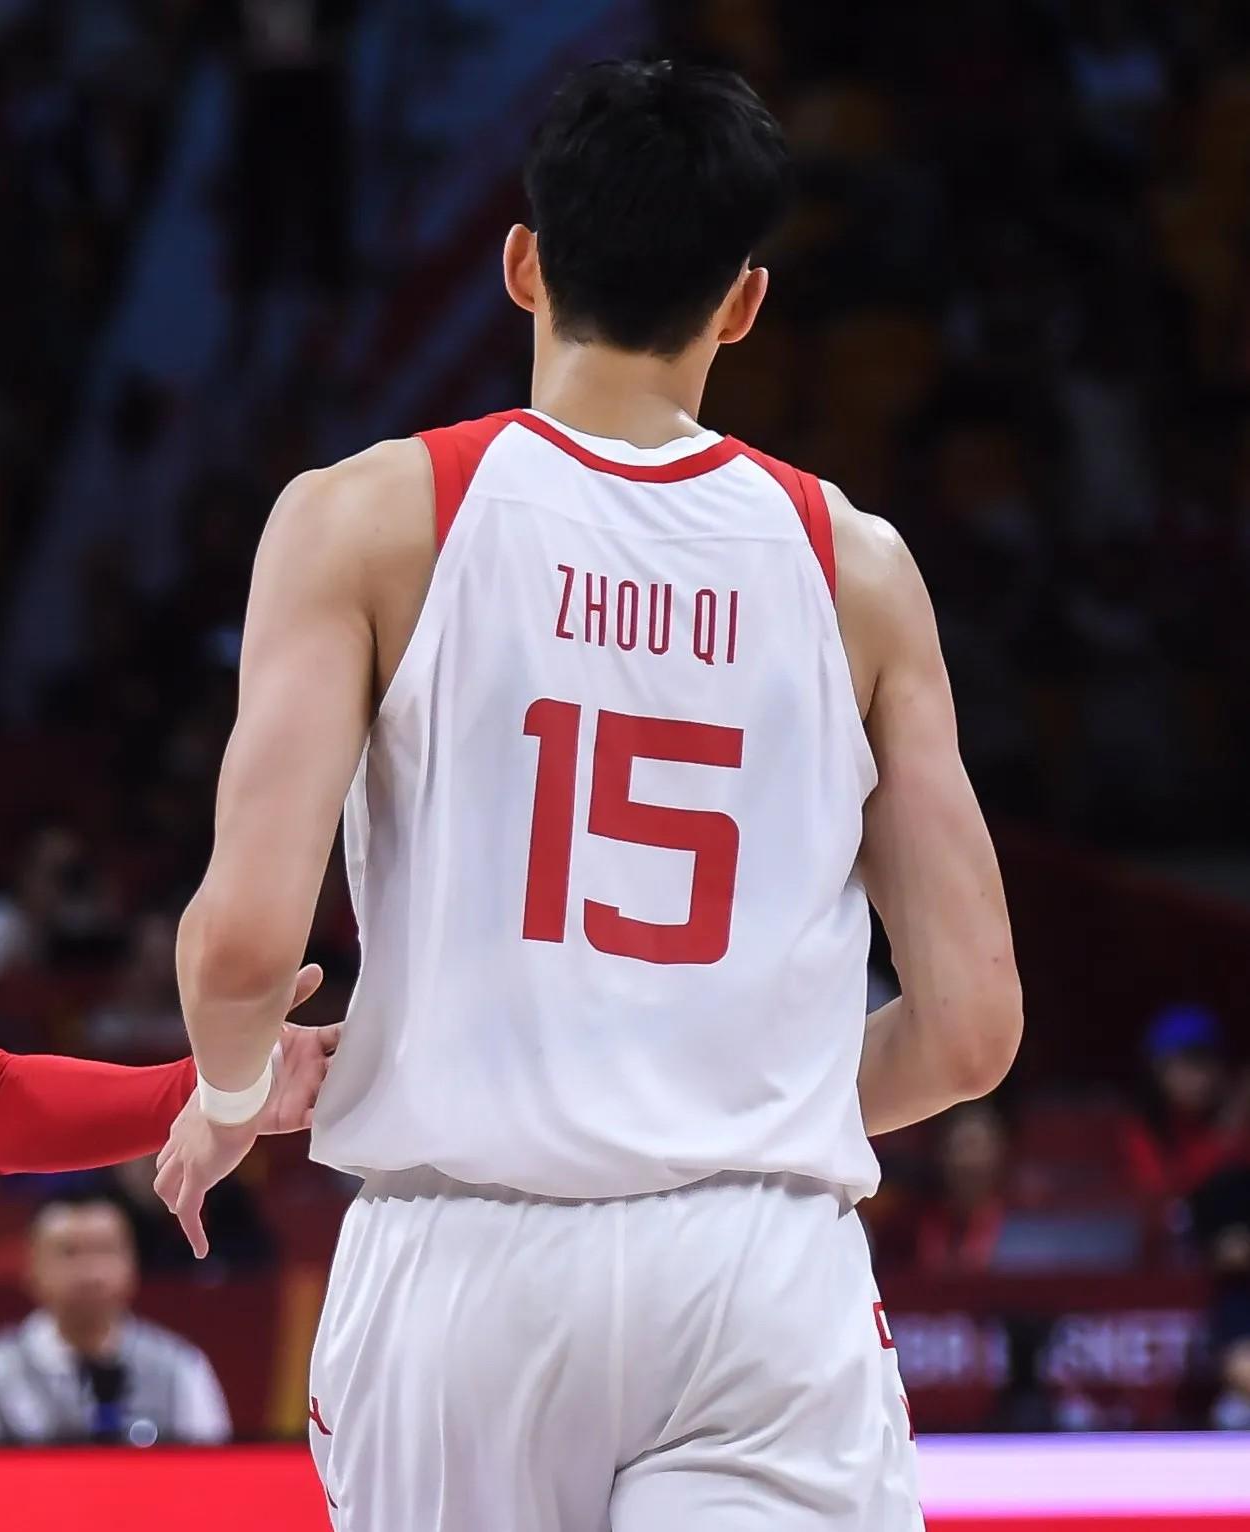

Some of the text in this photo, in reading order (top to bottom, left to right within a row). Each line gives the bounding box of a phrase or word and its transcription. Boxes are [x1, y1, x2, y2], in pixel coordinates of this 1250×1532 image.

[554, 564, 739, 665] ZHOU QI
[522, 698, 744, 965] 15
